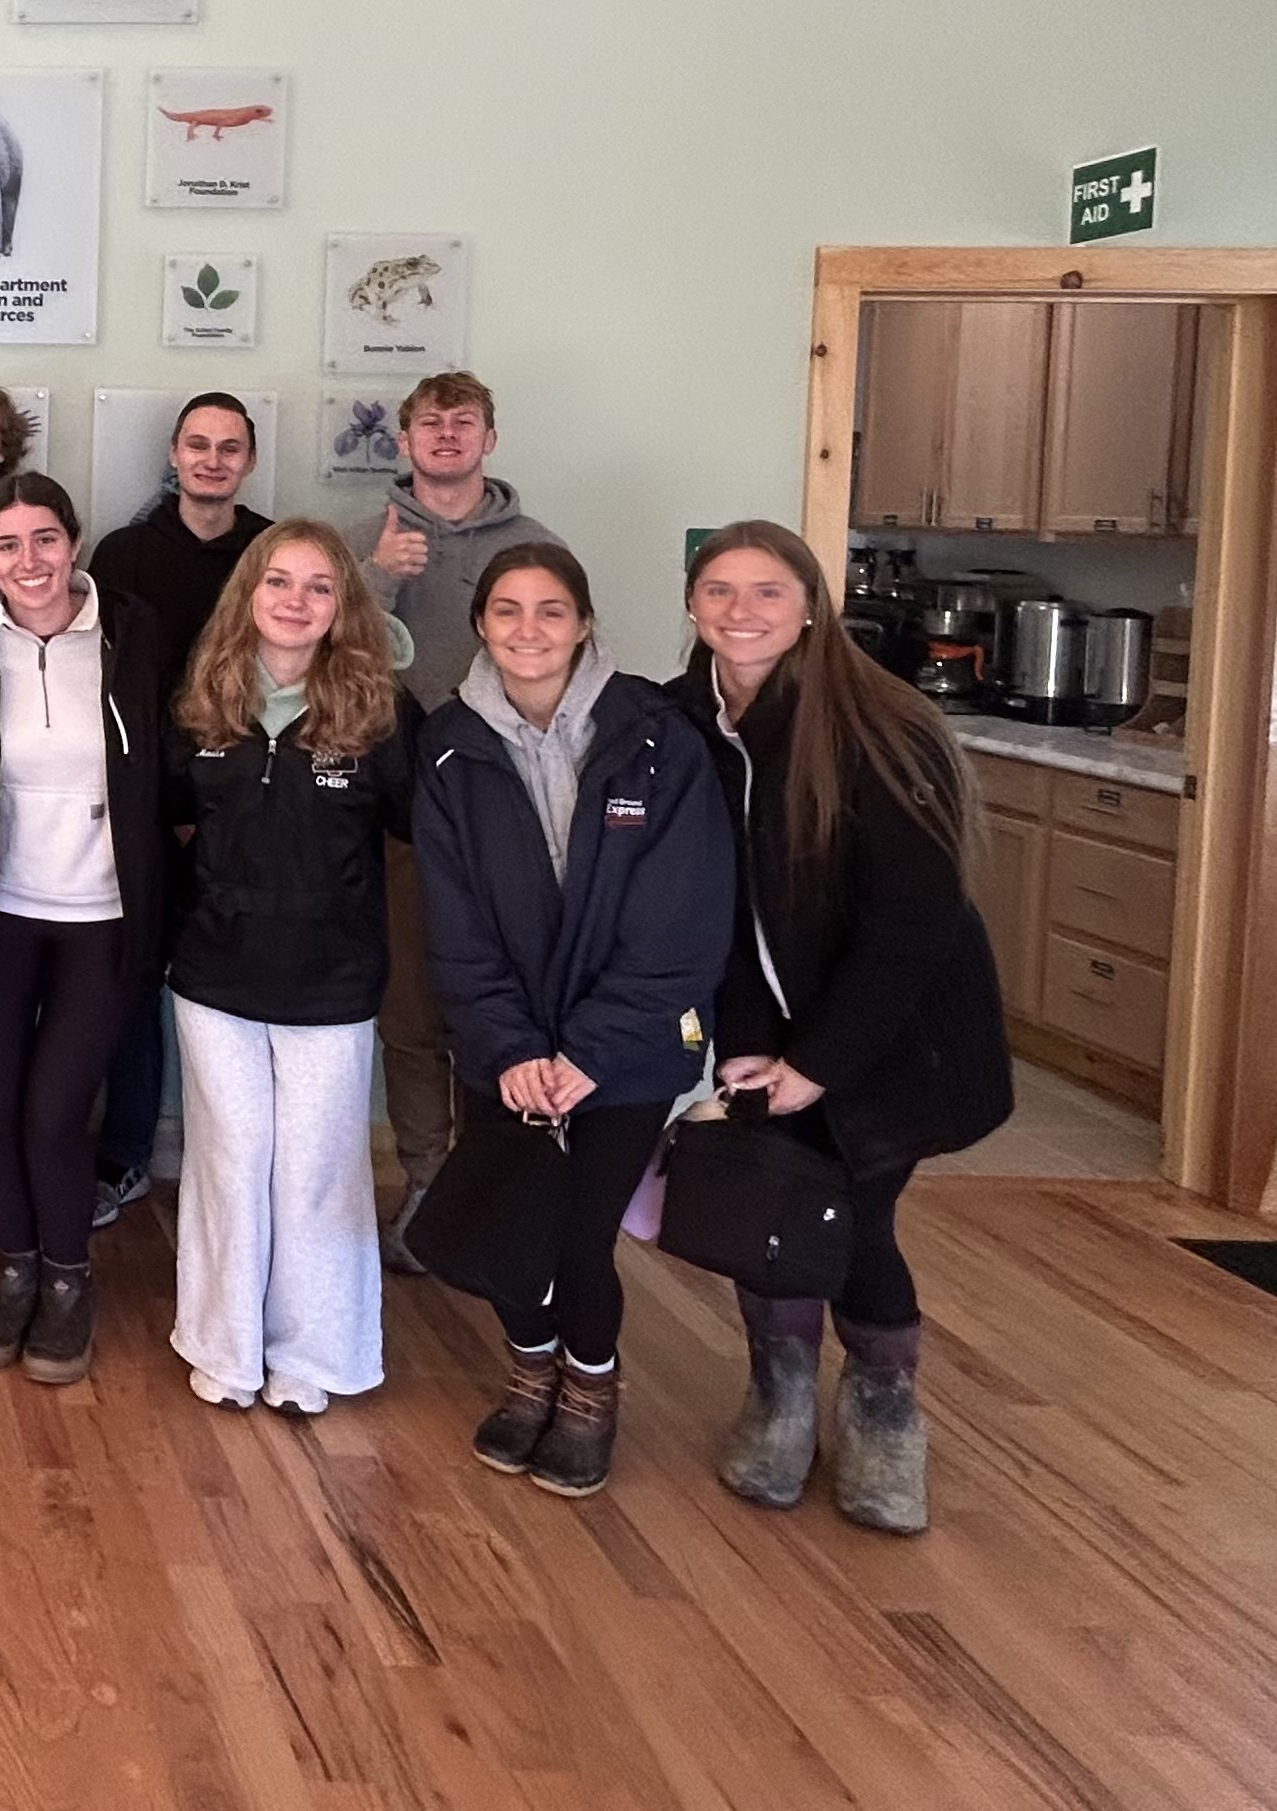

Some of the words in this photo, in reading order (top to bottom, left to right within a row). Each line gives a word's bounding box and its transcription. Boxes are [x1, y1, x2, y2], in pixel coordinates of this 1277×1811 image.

[189, 187, 239, 196] Foundation
[1073, 175, 1121, 203] FIRST
[1080, 203, 1110, 226] AID
[11, 293, 44, 307] and
[315, 775, 349, 789] CHEER
